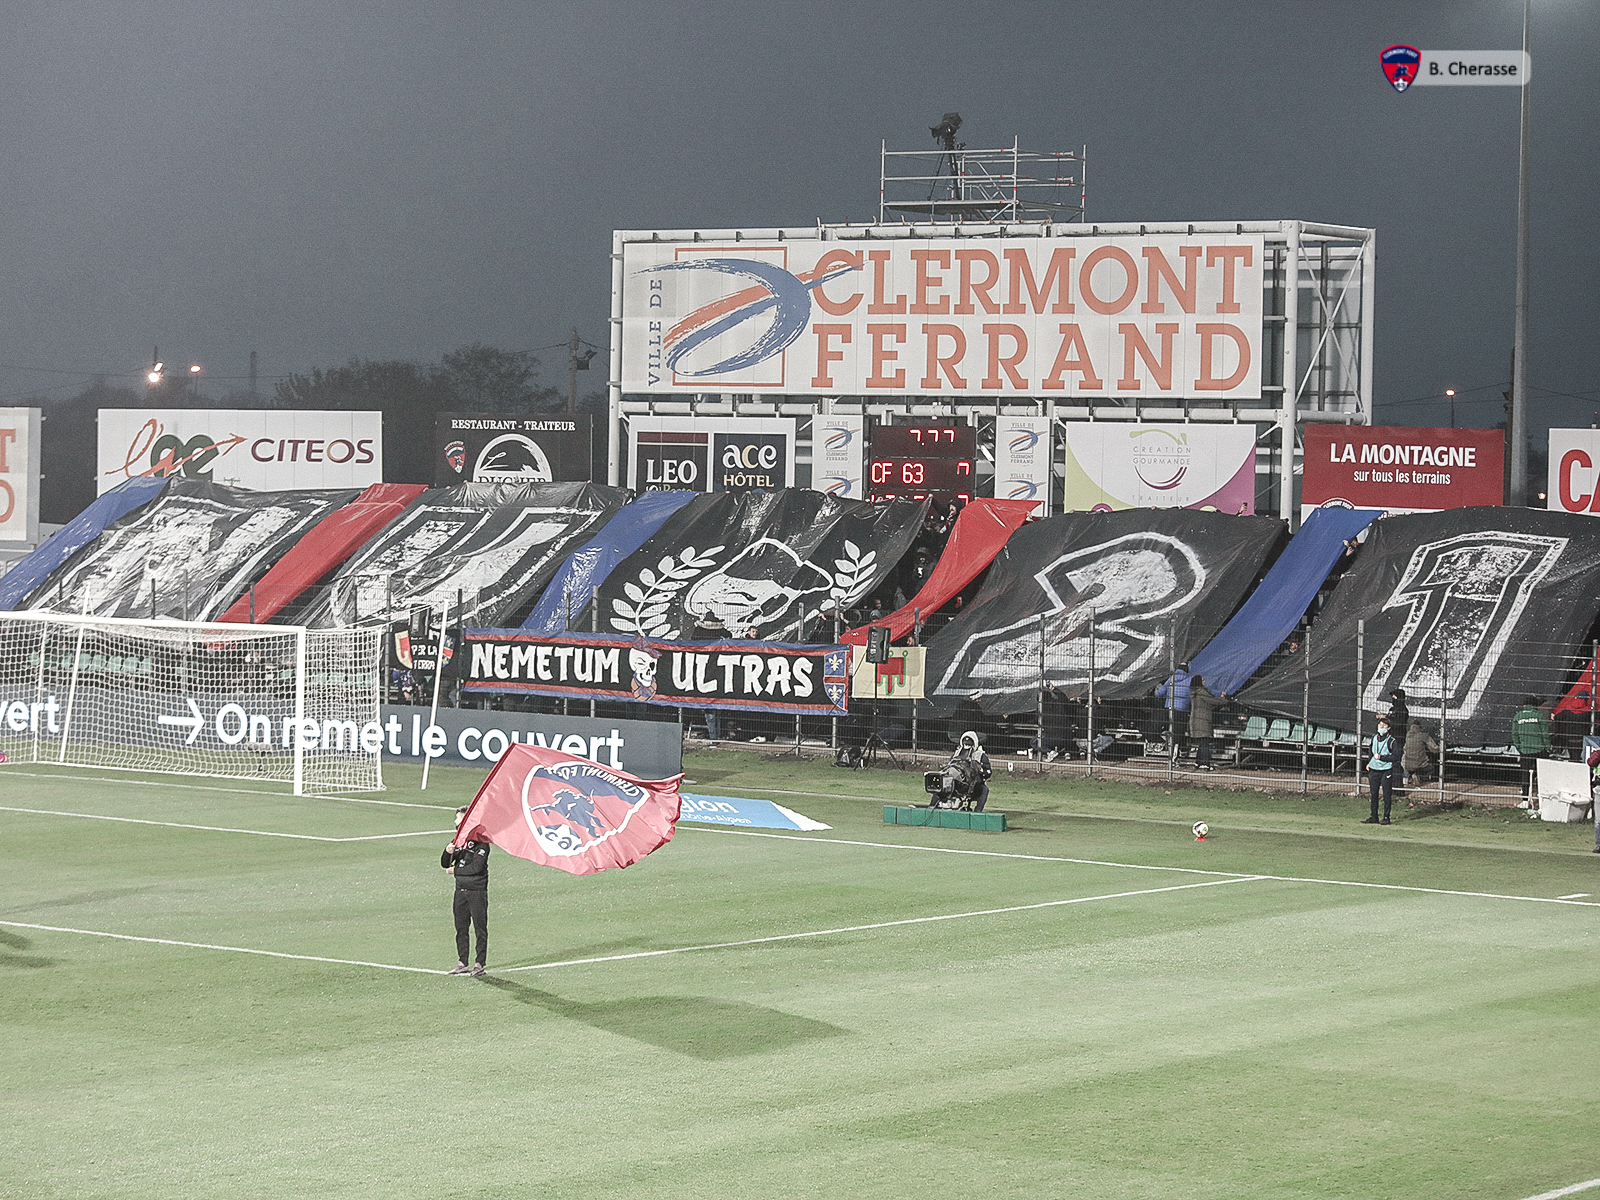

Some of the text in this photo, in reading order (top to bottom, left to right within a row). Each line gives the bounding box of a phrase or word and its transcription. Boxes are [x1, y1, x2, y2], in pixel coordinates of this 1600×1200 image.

[812, 245, 1252, 316] CLERMONT
[648, 278, 662, 386] VILLE DE
[811, 322, 1251, 391] FERRAND
[451, 419, 517, 430] RESTAURANT
[523, 420, 576, 431] TRAITEUR
[251, 437, 374, 464] CITEOS
[722, 444, 777, 470] ace
[1133, 446, 1191, 454] CREATION
[1133, 457, 1190, 465] GOURMANDE
[1330, 443, 1477, 468] LA MONTAGNE
[645, 459, 698, 484] LEO
[723, 472, 775, 487] HÔTEL
[871, 462, 893, 484] CF
[902, 462, 924, 484] 63
[1353, 469, 1451, 485] sur tous les terrains
[411, 644, 438, 656] PER LA
[470, 643, 815, 698] NEMETUM ULTRAS
[216, 703, 271, 746] On
[282, 713, 402, 756] remet
[412, 715, 448, 758] le
